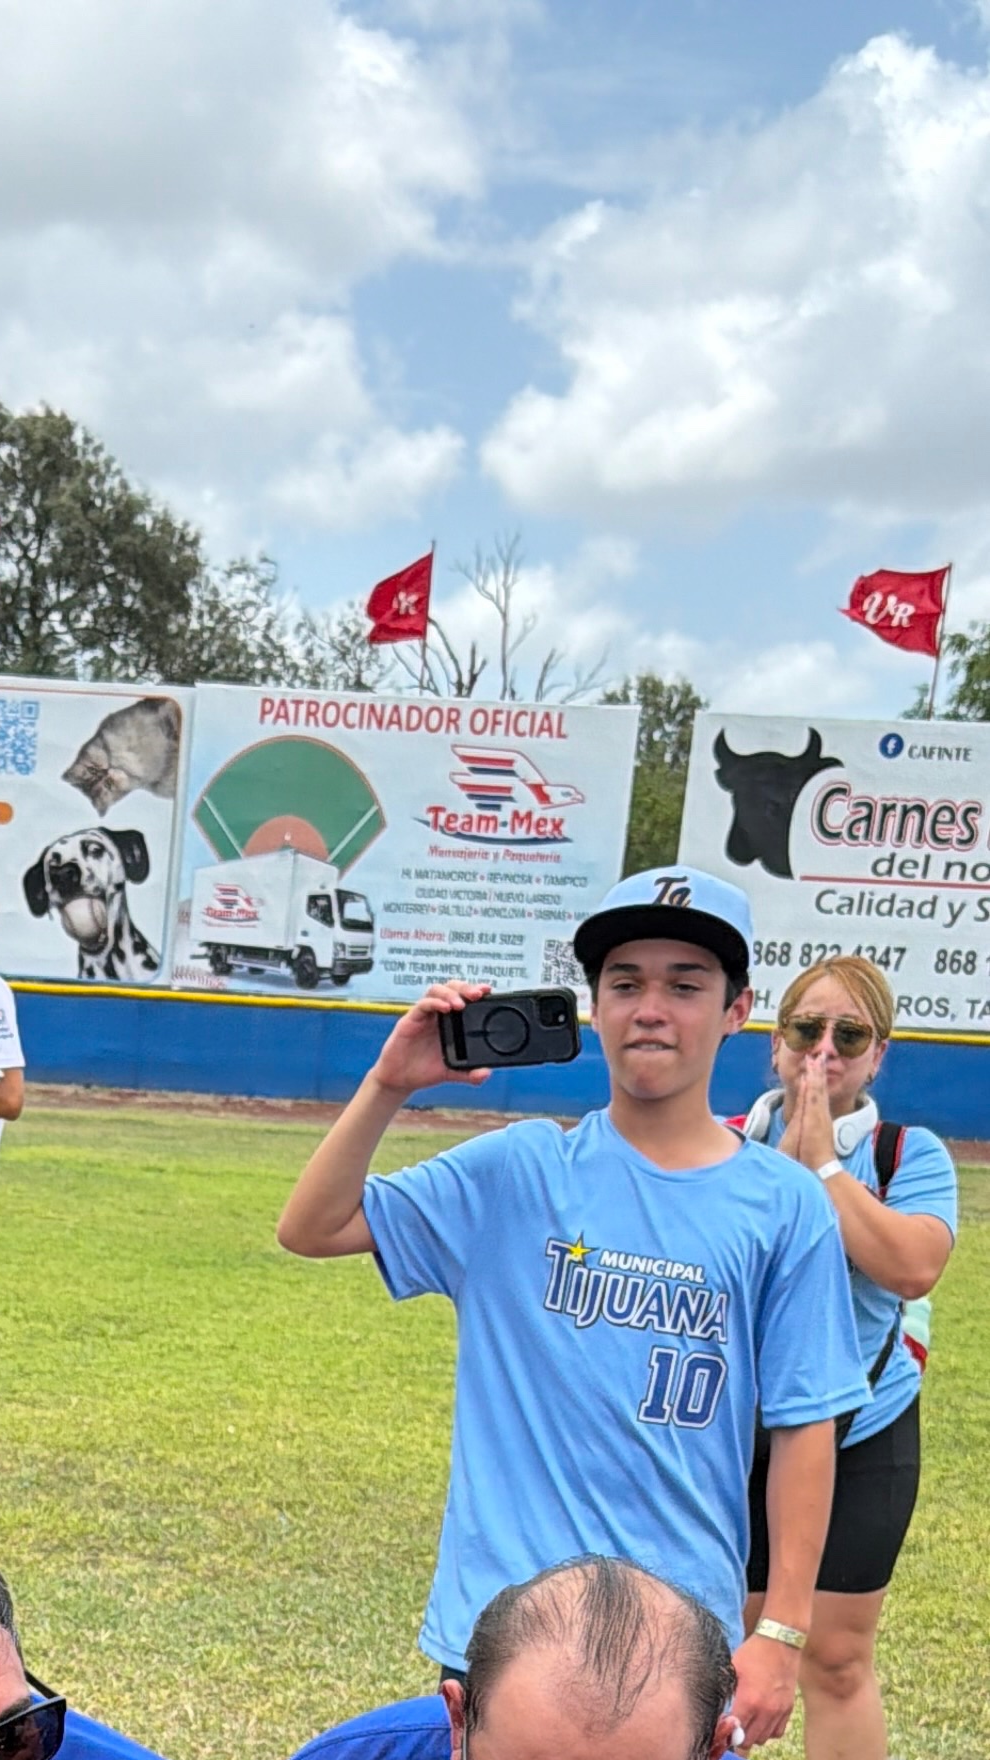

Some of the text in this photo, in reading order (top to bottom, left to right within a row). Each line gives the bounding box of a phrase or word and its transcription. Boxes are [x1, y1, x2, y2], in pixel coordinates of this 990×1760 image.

[259, 697, 568, 740] PATROCINADOR OFICIAL
[908, 743, 972, 763] CAFINTE
[812, 782, 981, 851] Carnes
[414, 869, 478, 882] MATAMOROS
[486, 872, 533, 884] REYNOSA
[543, 875, 588, 888] TAMPICO
[870, 852, 932, 880] del
[416, 888, 448, 899] CIUDAD
[450, 889, 488, 900] VICTORIA
[382, 903, 430, 914] MONTERREY
[815, 889, 938, 920] Calidad
[942, 901, 966, 929] y
[380, 928, 410, 940] Llama
[466, 965, 479, 976] TU
[934, 948, 978, 976] 868
[600, 1250, 706, 1284] MUNICIPAL
[545, 1238, 729, 1344] TIJUANA
[638, 1346, 728, 1430] 10
